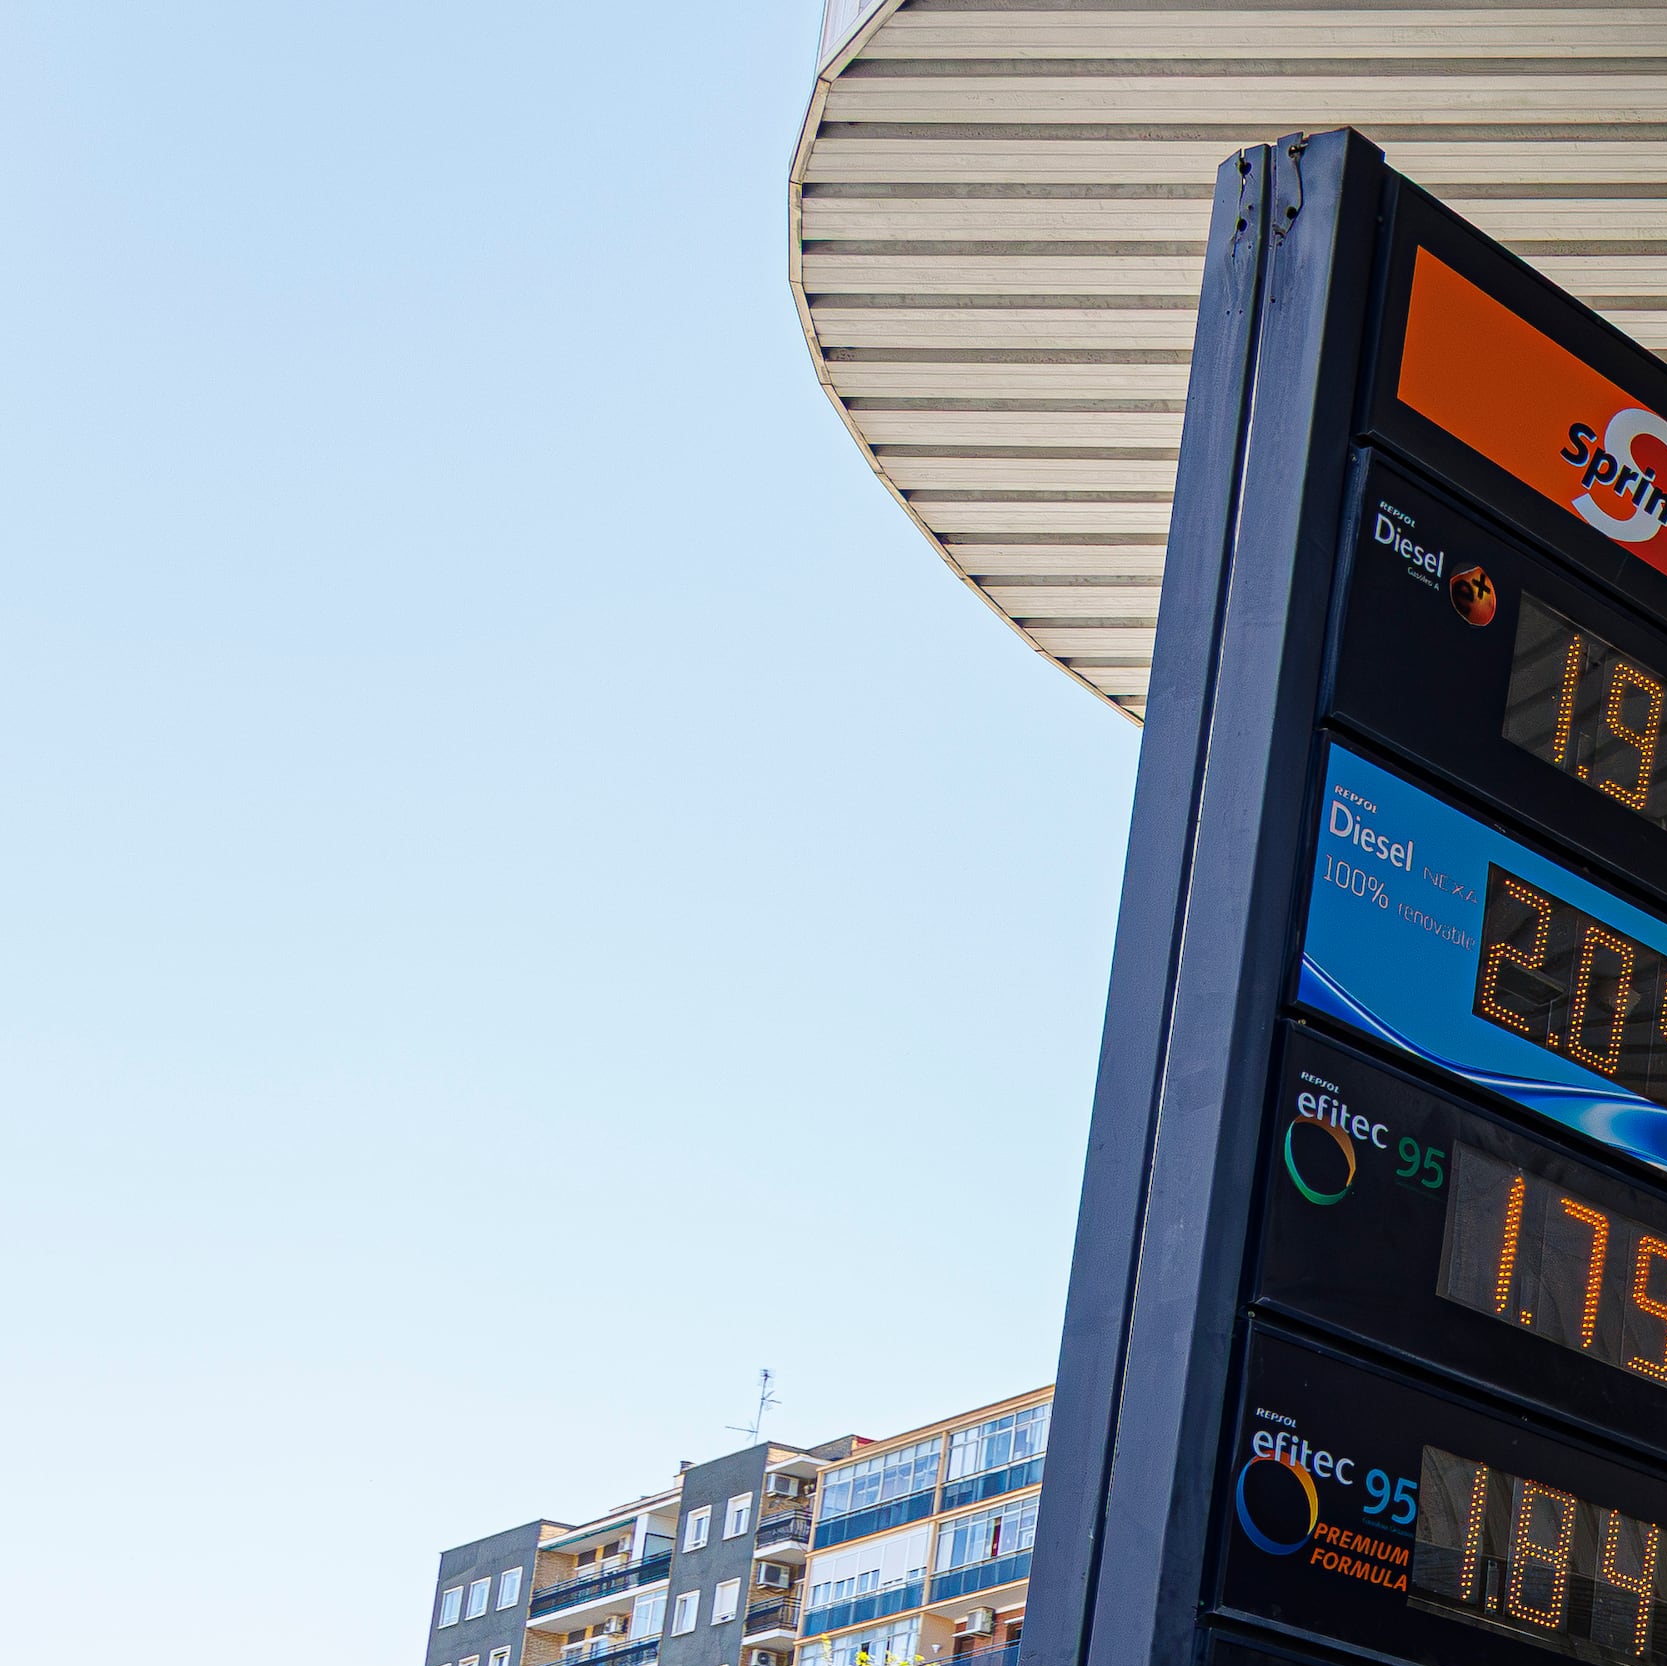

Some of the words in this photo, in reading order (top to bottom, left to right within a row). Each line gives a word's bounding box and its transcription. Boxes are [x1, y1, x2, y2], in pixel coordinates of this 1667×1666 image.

[1379, 501, 1416, 529] REPSOL
[1374, 512, 1444, 578] Diesel
[1334, 784, 1378, 814] REPSOL
[1329, 799, 1414, 872] Diesel
[1423, 866, 1478, 904] NEXA
[1323, 853, 1389, 910] 100%
[1300, 1071, 1340, 1094] REPSOL
[1297, 1090, 1388, 1150] efitec
[1396, 1136, 1446, 1189] 95
[1256, 1406, 1297, 1428] REPSOL
[1252, 1426, 1354, 1486] efitec
[1363, 1468, 1418, 1525] 95
[1314, 1522, 1410, 1567] PREMIUM
[1310, 1548, 1408, 1592] FORMULA
